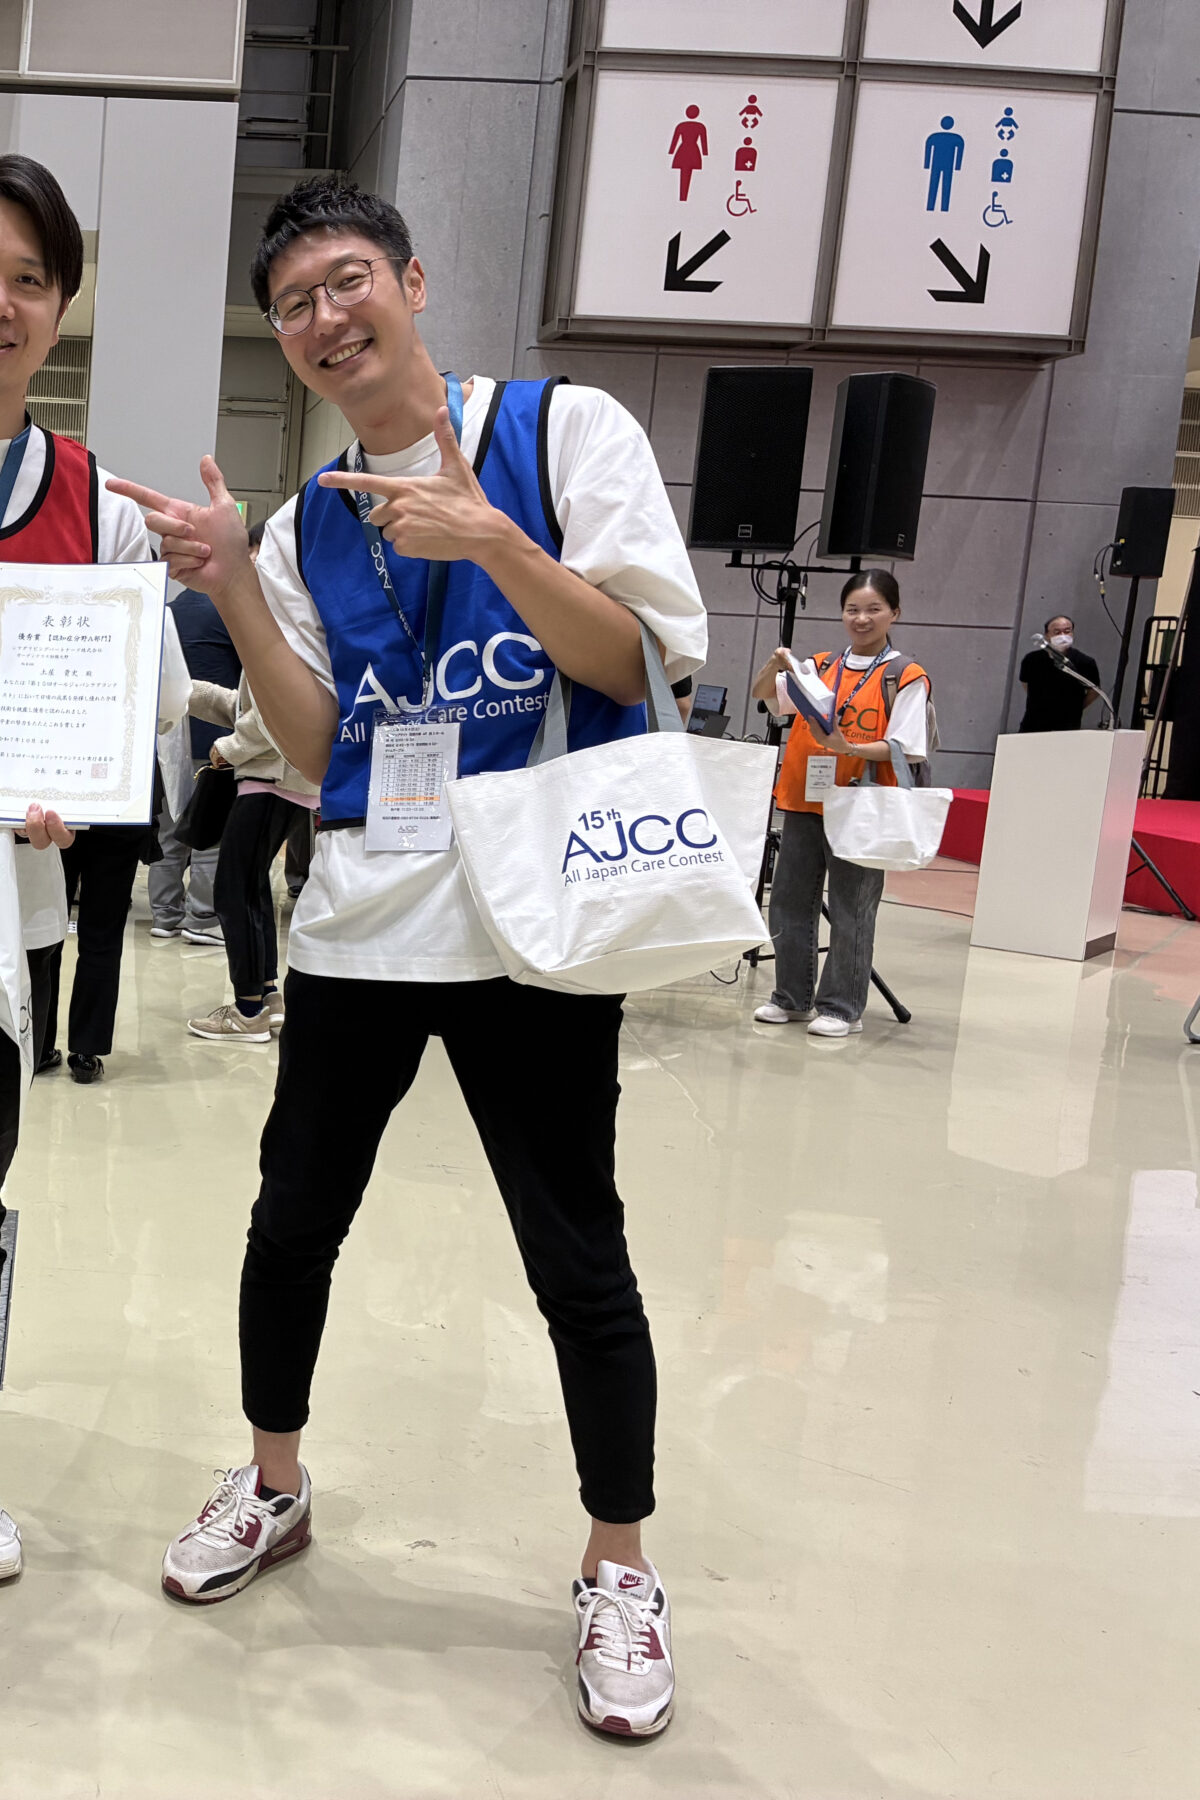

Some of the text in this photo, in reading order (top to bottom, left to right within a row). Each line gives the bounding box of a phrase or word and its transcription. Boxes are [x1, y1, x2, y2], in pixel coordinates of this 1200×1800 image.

[370, 542, 392, 589] AJCC
[18, 633, 41, 641] 優秀賞
[42, 614, 91, 628] 表彰状
[342, 631, 546, 724] AJCC
[340, 722, 367, 744] All
[425, 704, 468, 725] Care
[472, 692, 549, 720] Contest
[839, 704, 880, 732] CC
[577, 808, 622, 831] 15th
[561, 808, 718, 875] AJCC
[564, 850, 725, 887] All Japan Care Contest
[623, 1572, 645, 1585] NIKE
